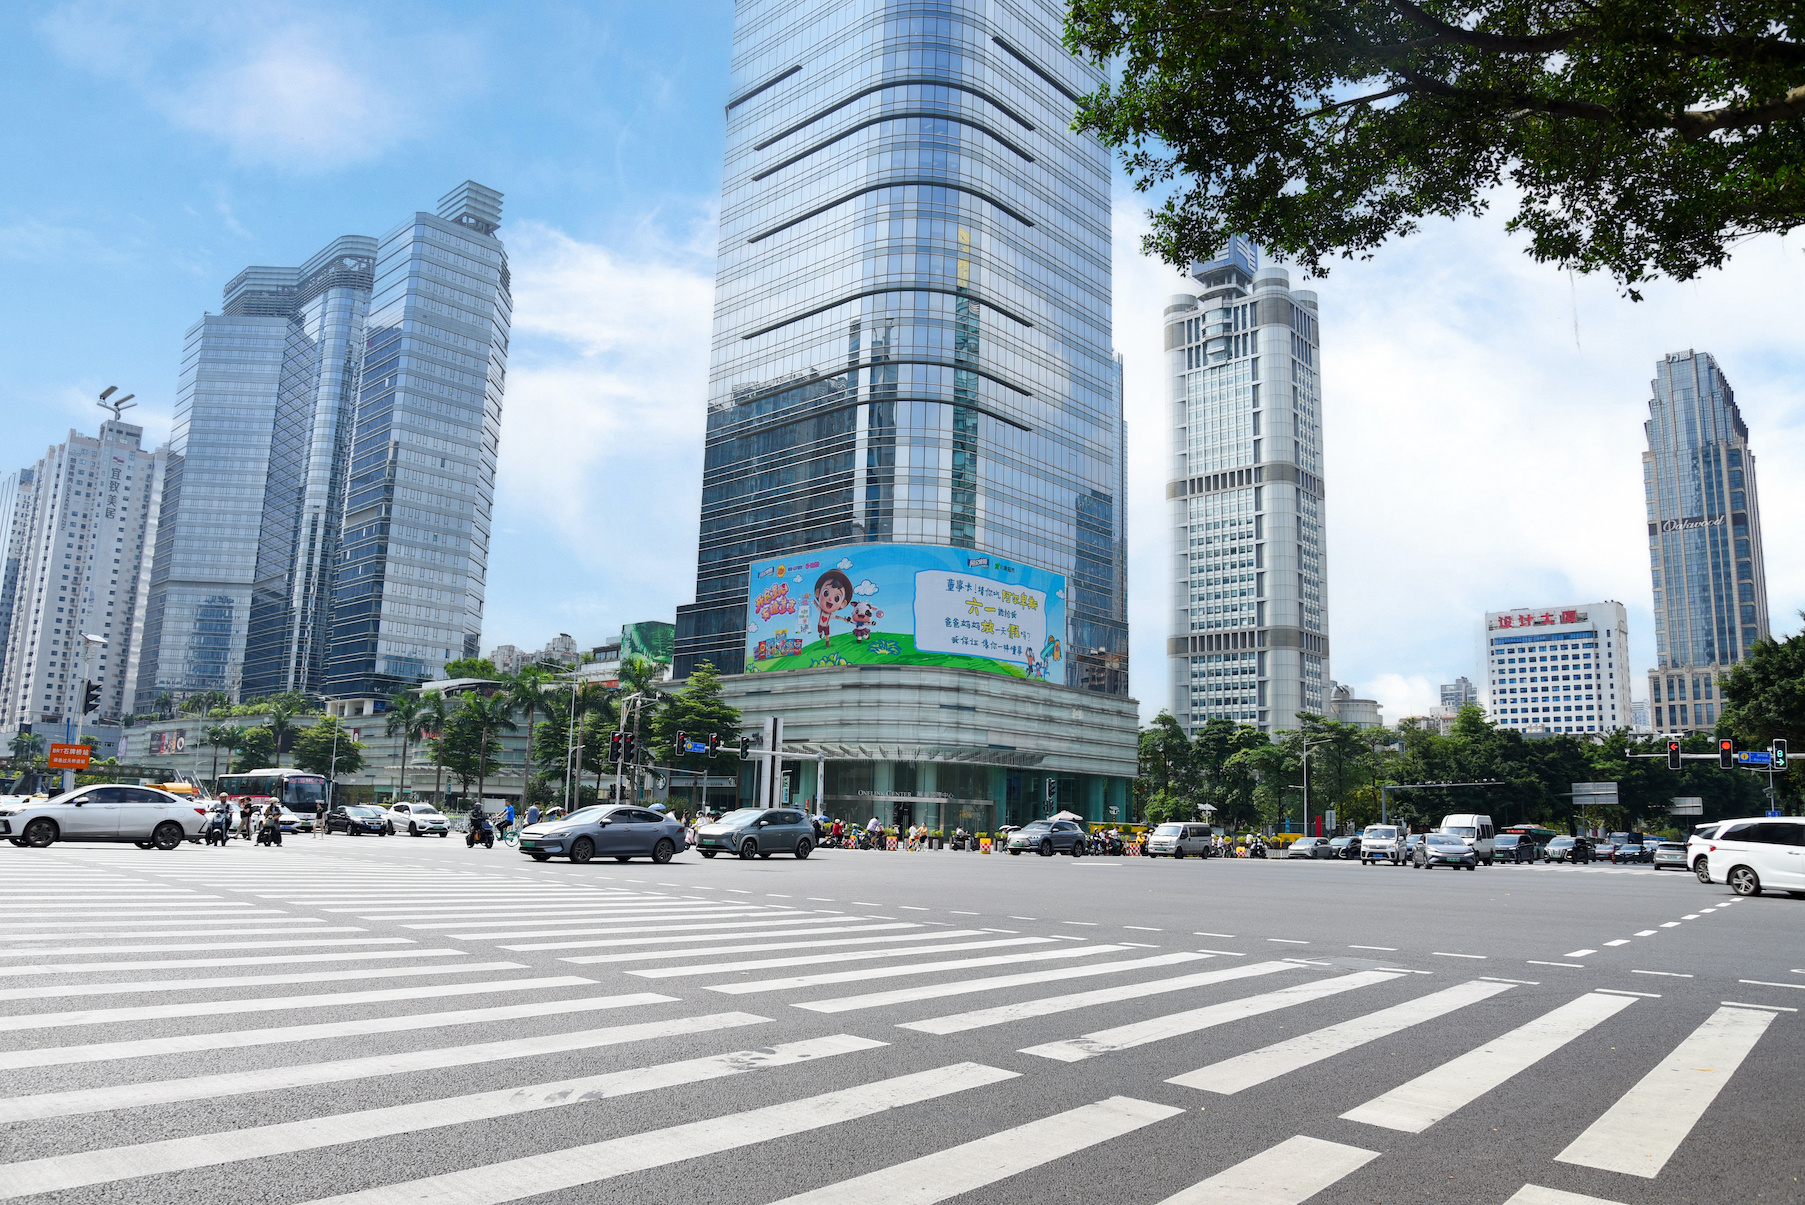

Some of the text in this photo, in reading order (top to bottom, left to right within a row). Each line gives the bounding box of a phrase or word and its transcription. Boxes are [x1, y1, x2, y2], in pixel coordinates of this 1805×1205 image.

[105, 468, 121, 519] 宜致美居
[1663, 514, 1725, 532] Oakwood
[1498, 609, 1577, 628] 设计大厦
